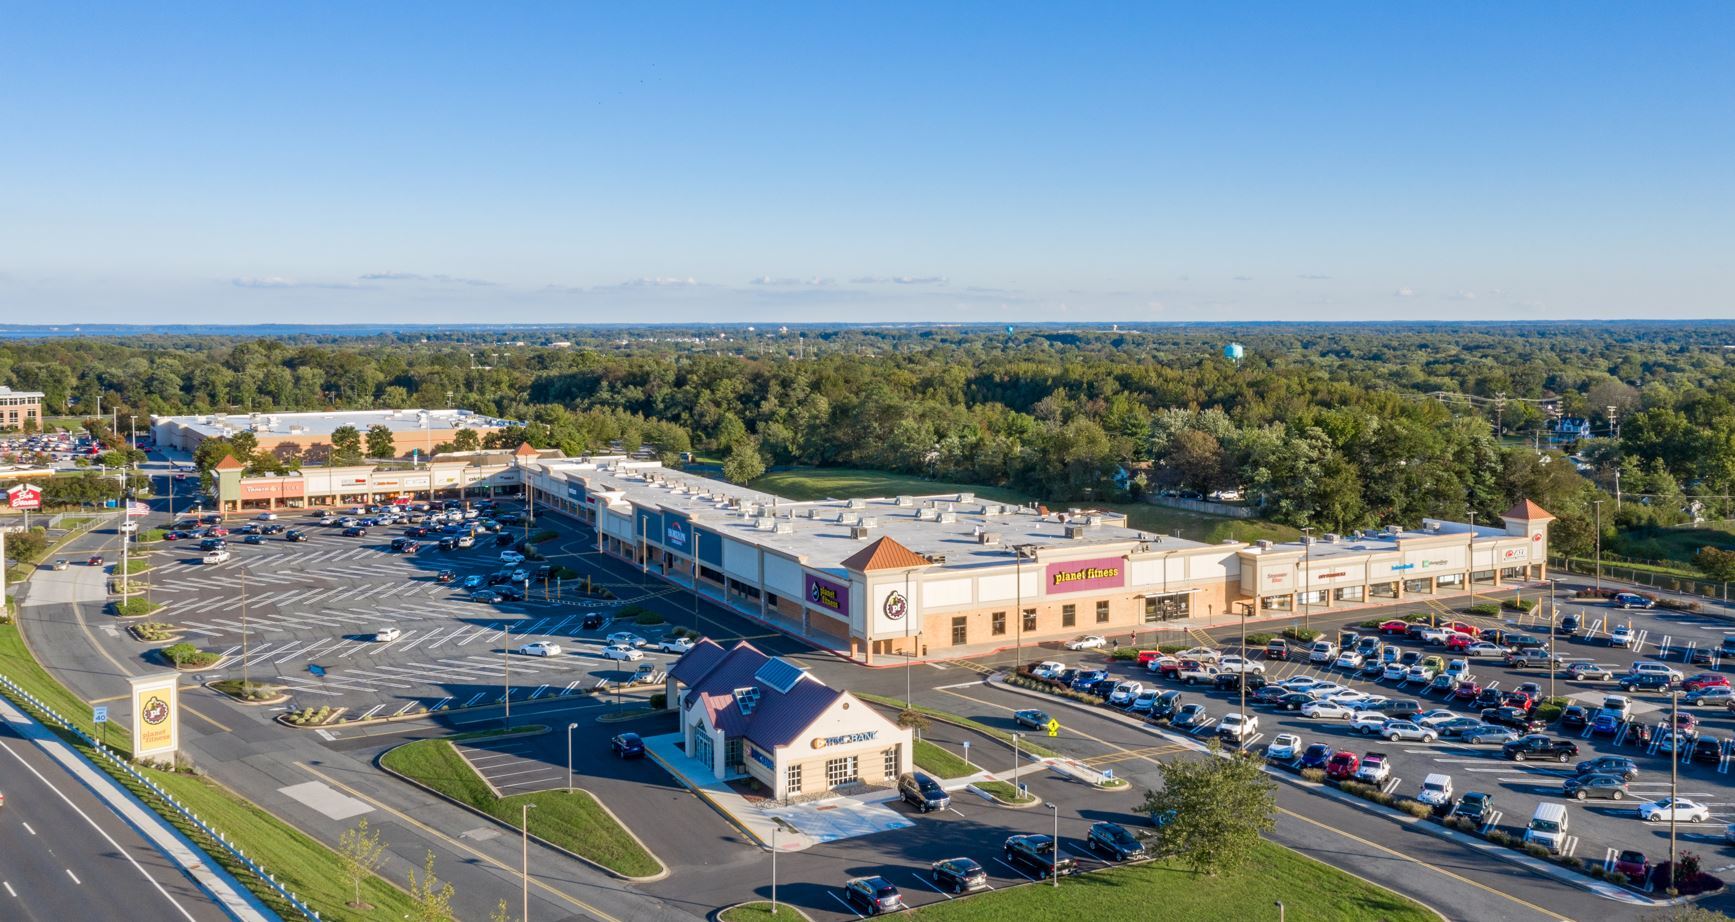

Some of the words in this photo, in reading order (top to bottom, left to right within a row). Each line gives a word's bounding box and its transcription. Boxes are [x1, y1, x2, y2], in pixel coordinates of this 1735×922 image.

[17, 491, 34, 499] Bob
[1055, 571, 1086, 584] planet
[1088, 568, 1119, 579] fitness
[820, 587, 835, 598] planet
[822, 595, 839, 608] fitness
[149, 706, 162, 719] pf
[143, 730, 166, 739] planet
[146, 734, 170, 743] fitness
